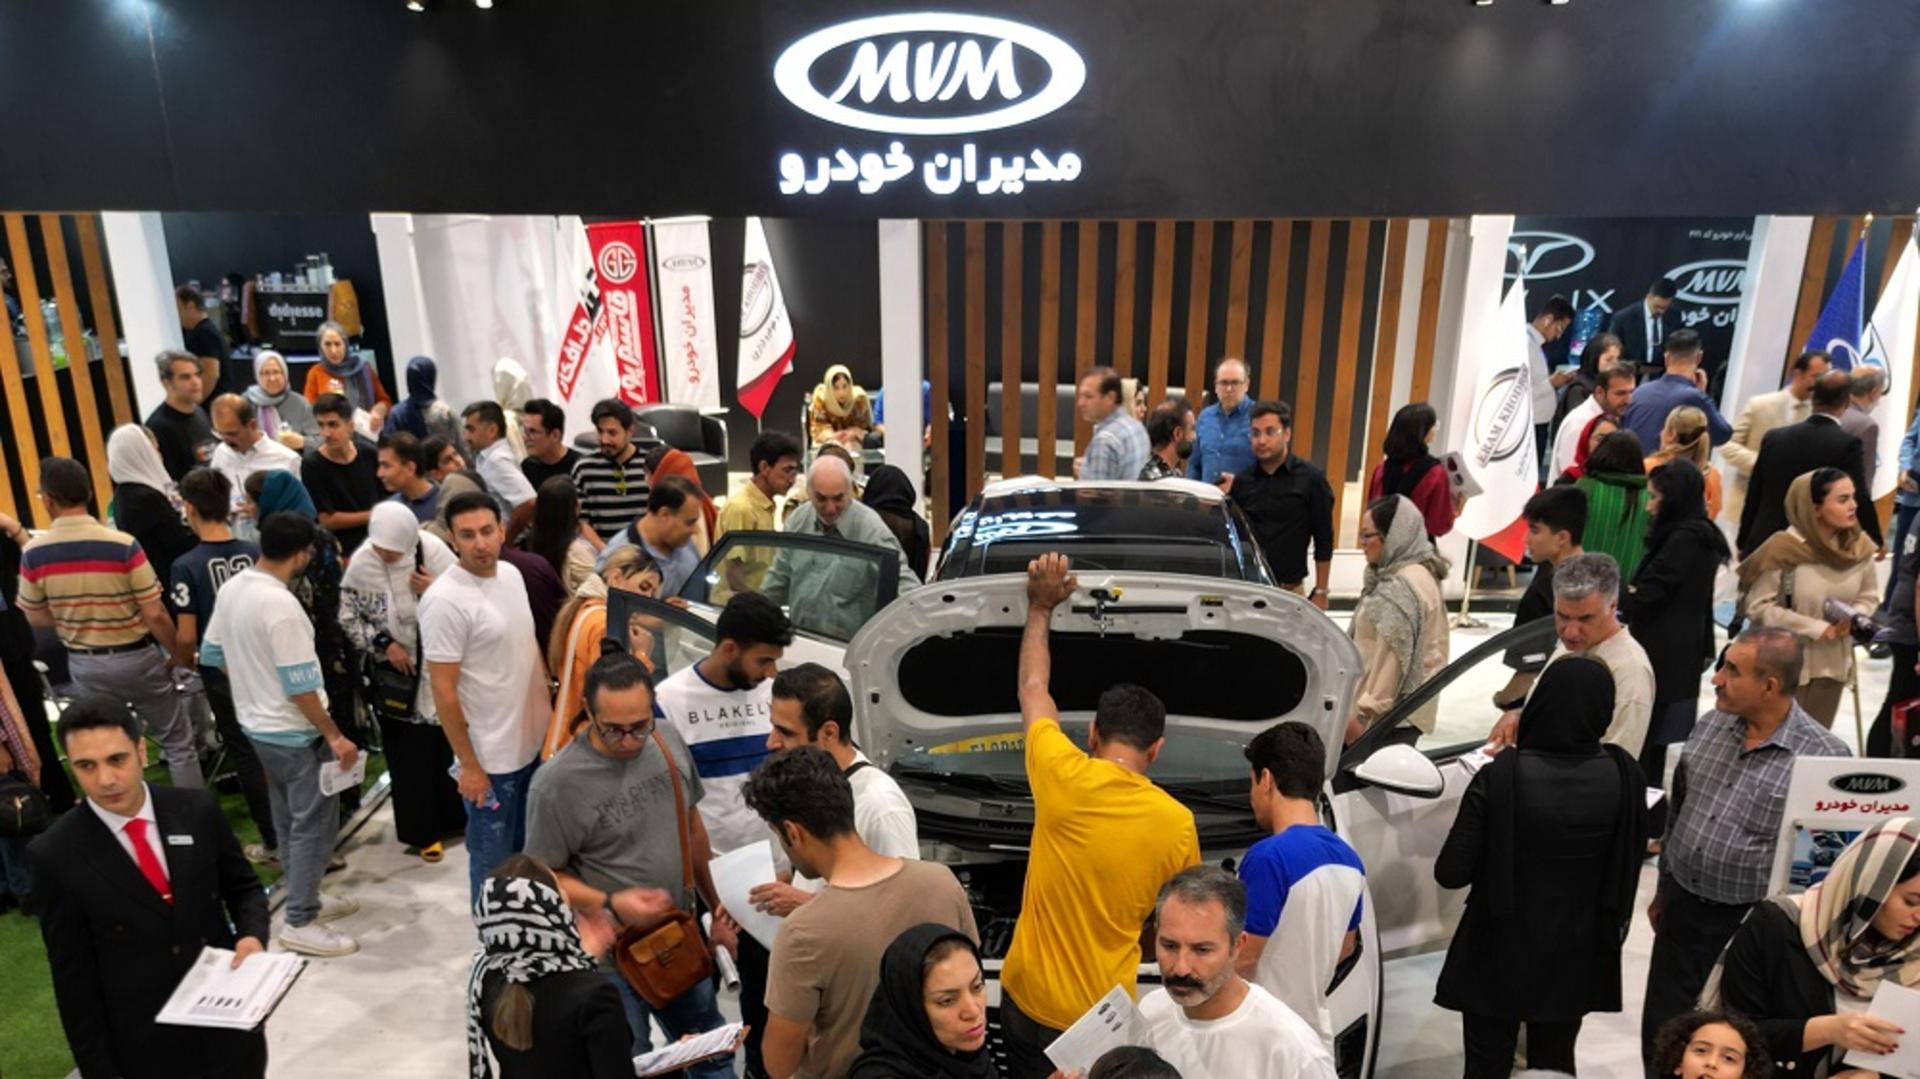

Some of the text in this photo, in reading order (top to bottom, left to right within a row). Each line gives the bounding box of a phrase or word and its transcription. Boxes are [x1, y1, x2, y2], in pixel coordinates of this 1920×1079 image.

[829, 40, 1022, 104] MVM
[779, 141, 1082, 195] مدیران خودرو
[687, 702, 769, 725] BLAKEL
[1845, 776, 1891, 791] MVM
[1814, 799, 1909, 814] مدیران خودرو
